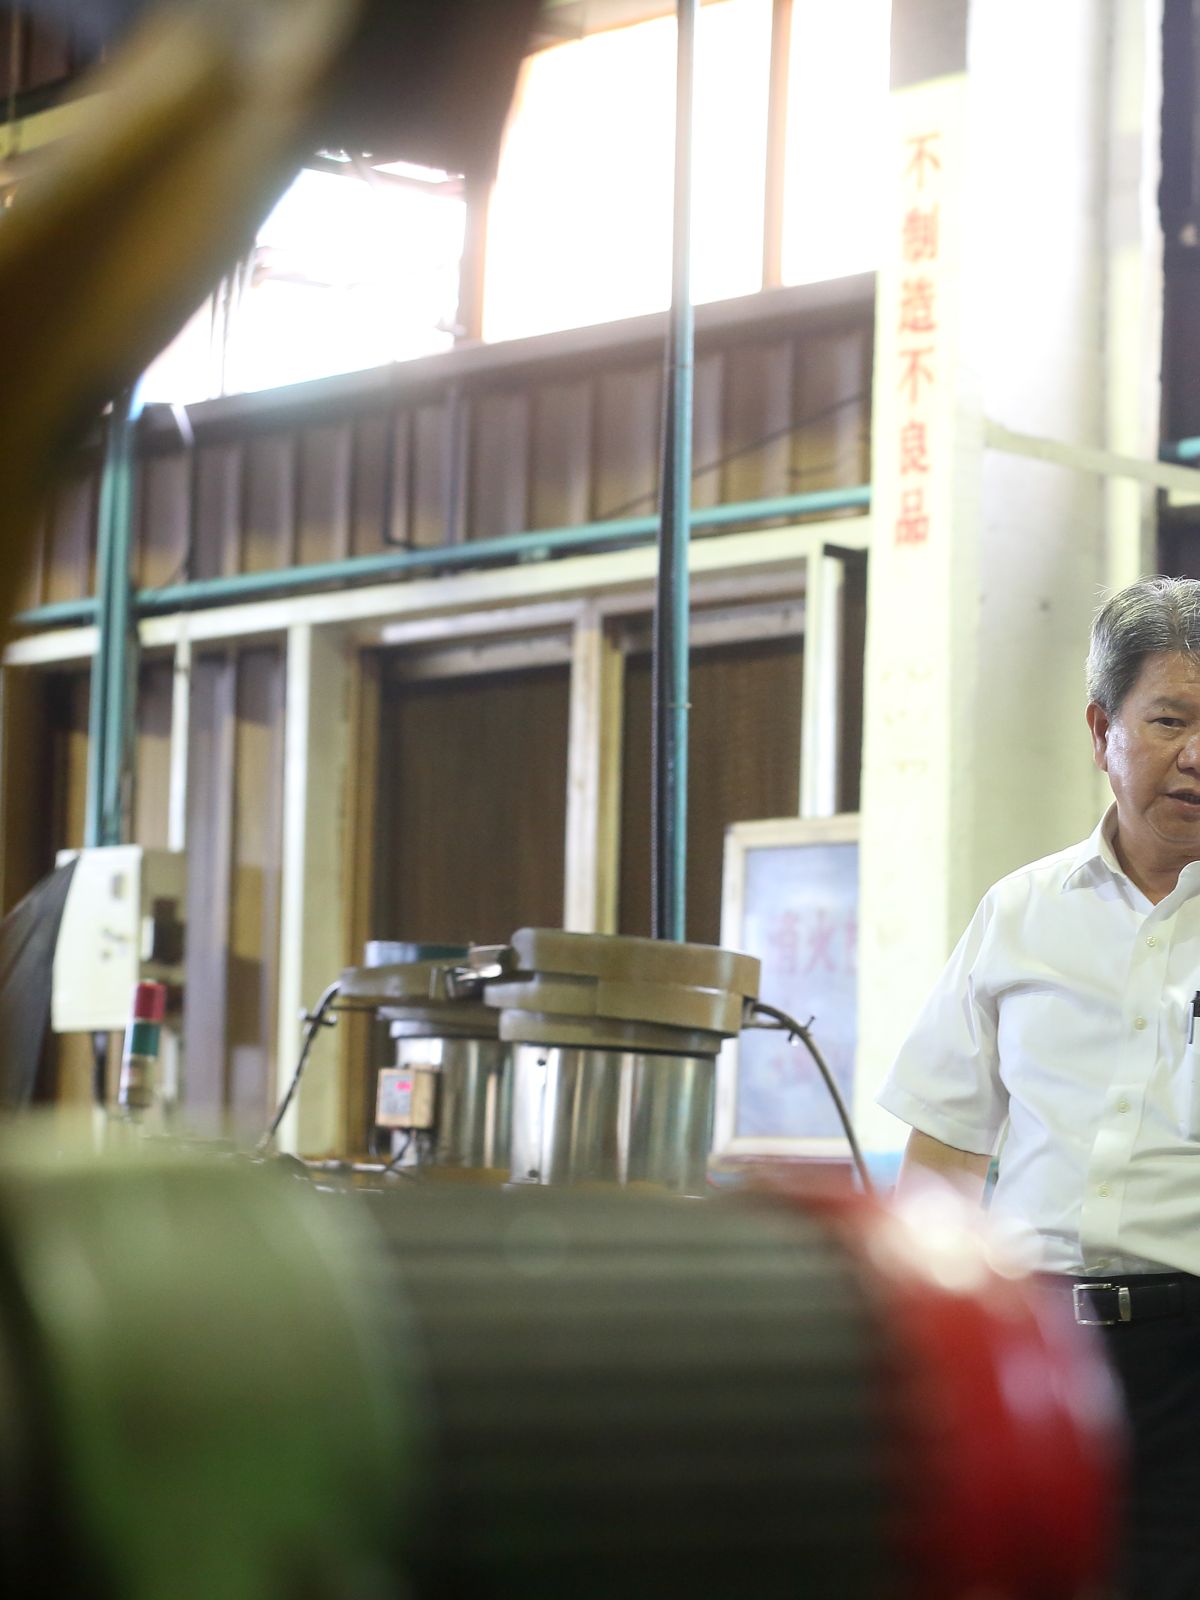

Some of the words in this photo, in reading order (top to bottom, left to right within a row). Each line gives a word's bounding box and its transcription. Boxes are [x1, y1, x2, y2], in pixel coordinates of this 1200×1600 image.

[896, 131, 942, 545] 不制造不良品
